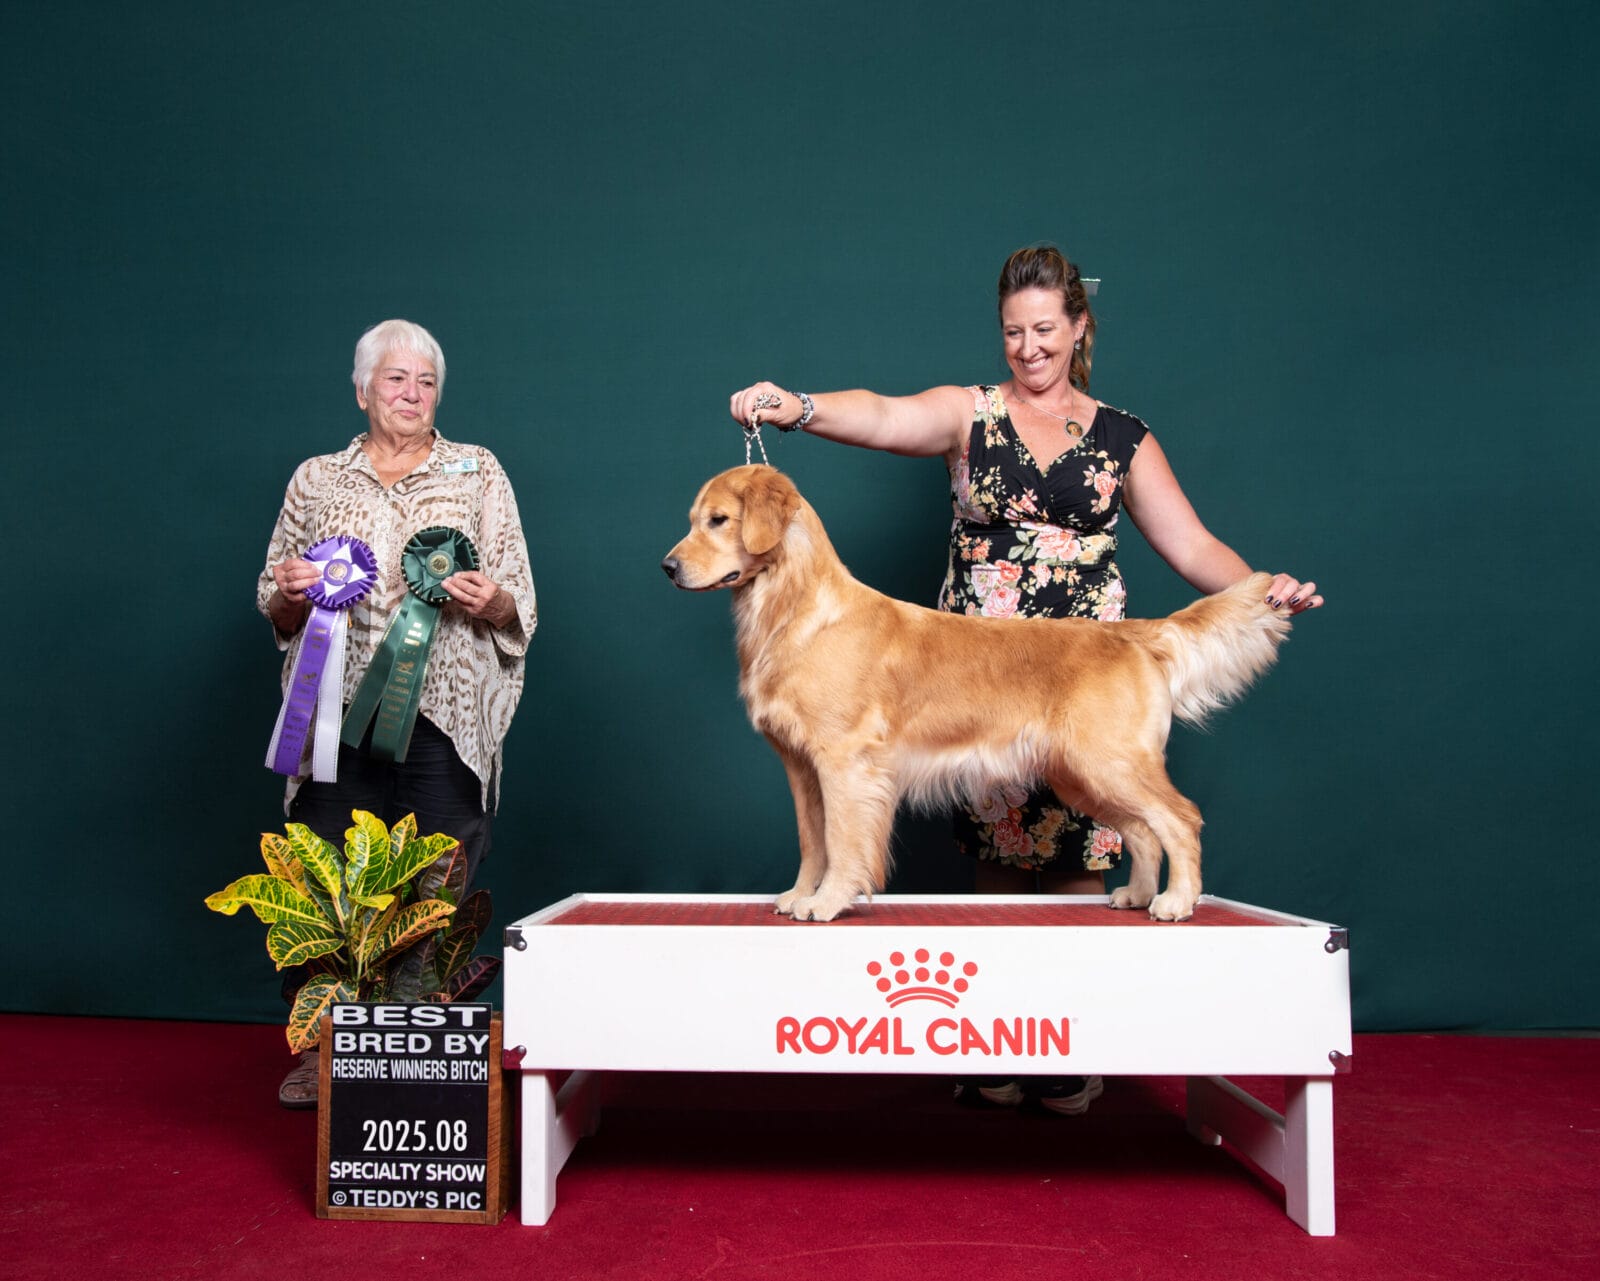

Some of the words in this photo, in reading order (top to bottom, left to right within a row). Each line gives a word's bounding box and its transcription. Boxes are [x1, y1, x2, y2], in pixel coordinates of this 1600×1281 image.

[333, 1005, 487, 1027] BEST
[335, 1032, 431, 1054] BRED
[444, 1034, 489, 1055] BY
[776, 1016, 915, 1055] ROYAL
[926, 1017, 1071, 1057] CANIN
[332, 1058, 388, 1079] RESERVE
[391, 1059, 447, 1080] WINNERS
[451, 1060, 488, 1081] BITCH
[362, 1119, 468, 1152] 2025.08
[330, 1161, 421, 1180] SPECIALTY
[426, 1164, 486, 1182] SHOW
[446, 1192, 481, 1210] PIC
